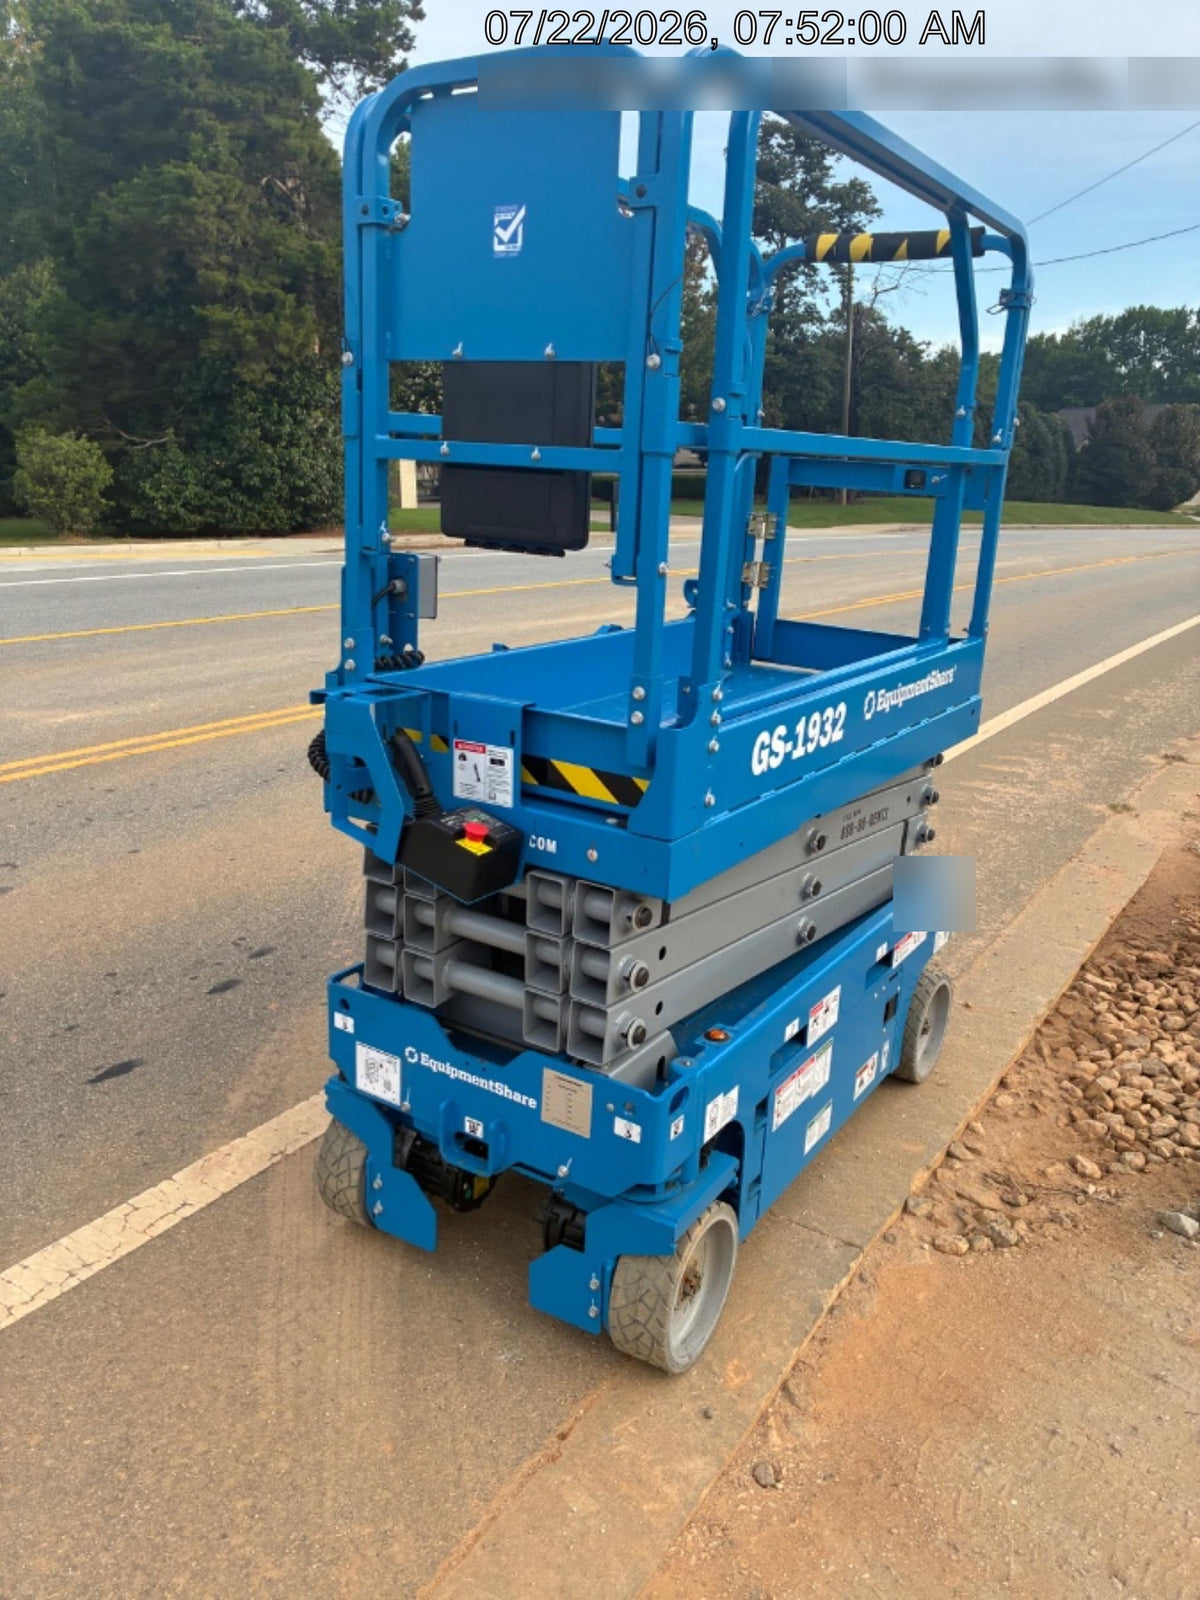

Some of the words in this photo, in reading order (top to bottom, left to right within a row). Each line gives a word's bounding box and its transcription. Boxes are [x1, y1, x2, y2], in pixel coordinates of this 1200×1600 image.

[876, 669, 955, 713] EquipmentShare
[751, 701, 847, 776] GS-1932
[420, 1052, 538, 1109] EquipmentShare
